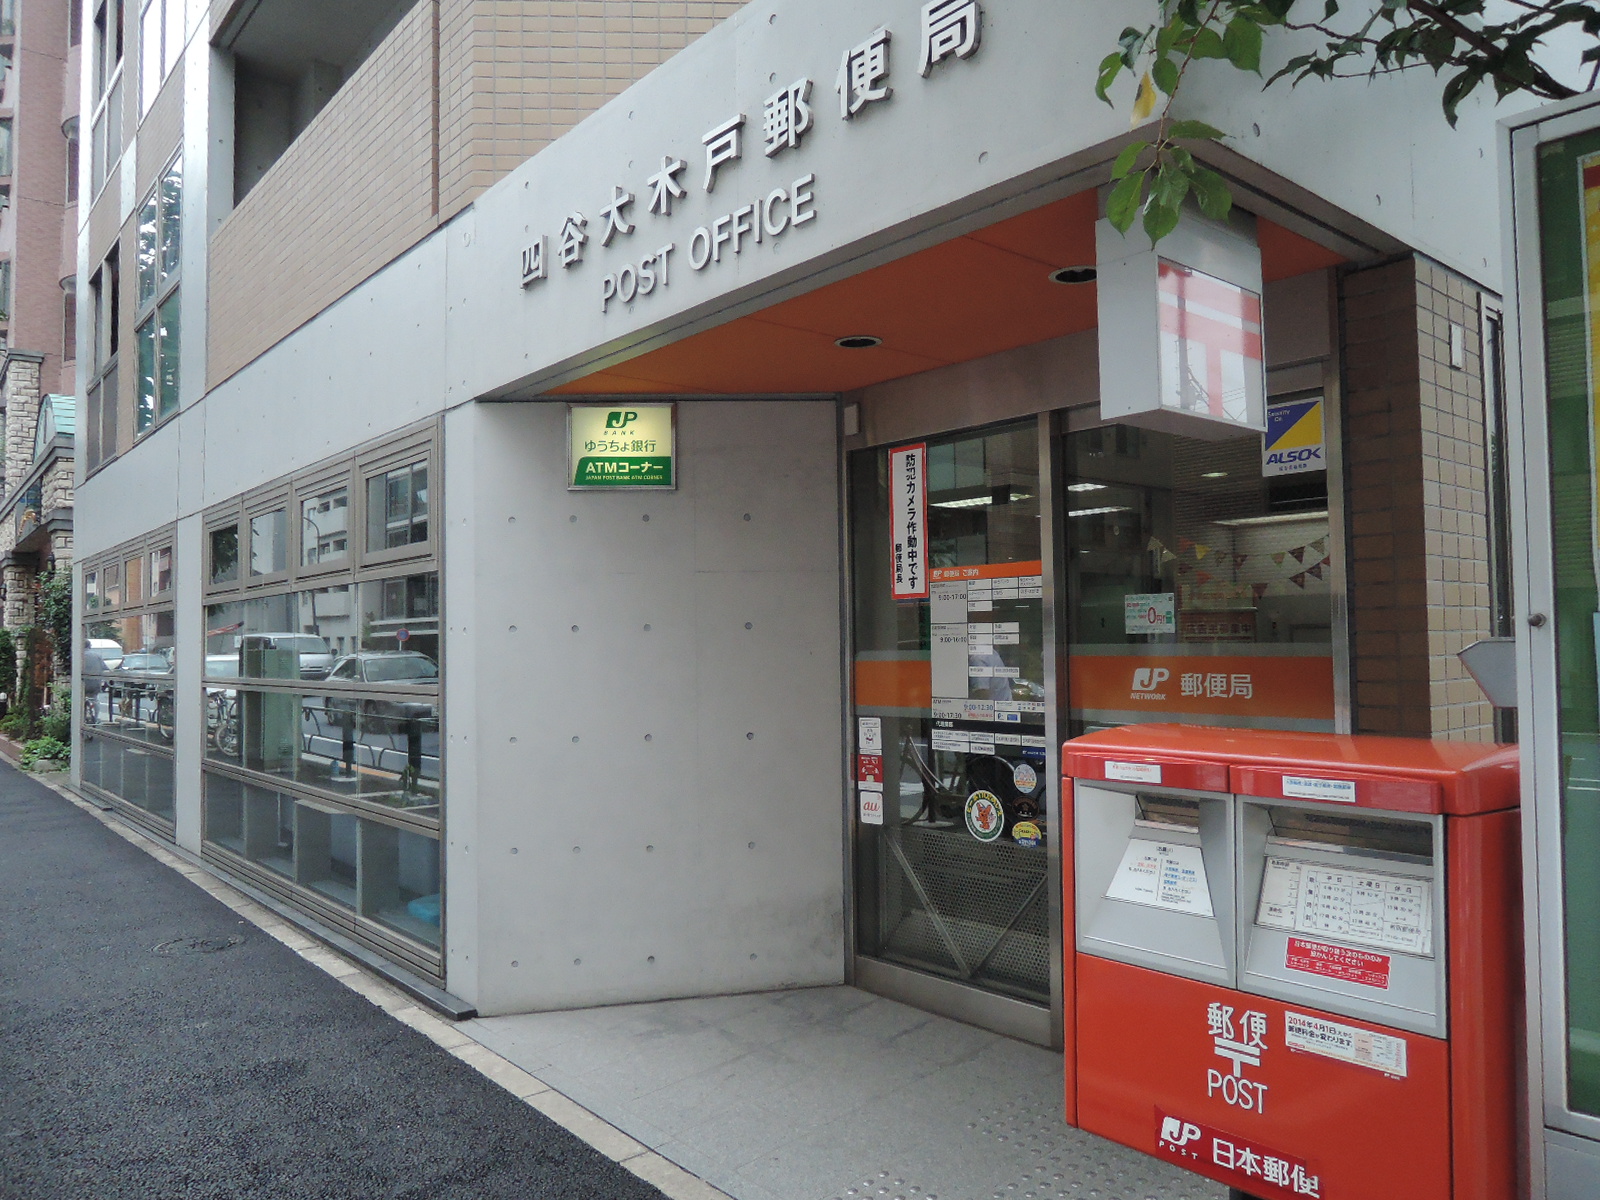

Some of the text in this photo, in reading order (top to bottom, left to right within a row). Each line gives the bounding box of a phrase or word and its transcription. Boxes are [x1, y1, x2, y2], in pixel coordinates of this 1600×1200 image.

[520, 0, 981, 290] 四谷大木戸郵便局
[601, 173, 817, 313] POST OFFICE
[584, 440, 657, 452] ゆうちょ銀行
[1266, 447, 1321, 465] ALSOK
[585, 461, 663, 473] ATMコーナー
[905, 453, 918, 589] 防犯カメラ作動中です
[1131, 667, 1170, 691] JP
[1180, 672, 1253, 699] 郵便局
[1130, 692, 1166, 701] NETWORK
[863, 801, 880, 811] au
[1207, 1002, 1269, 1050] 郵便
[1207, 1068, 1268, 1114] POST
[1159, 1140, 1198, 1160] POST
[1213, 1138, 1320, 1199] 日本郵便
